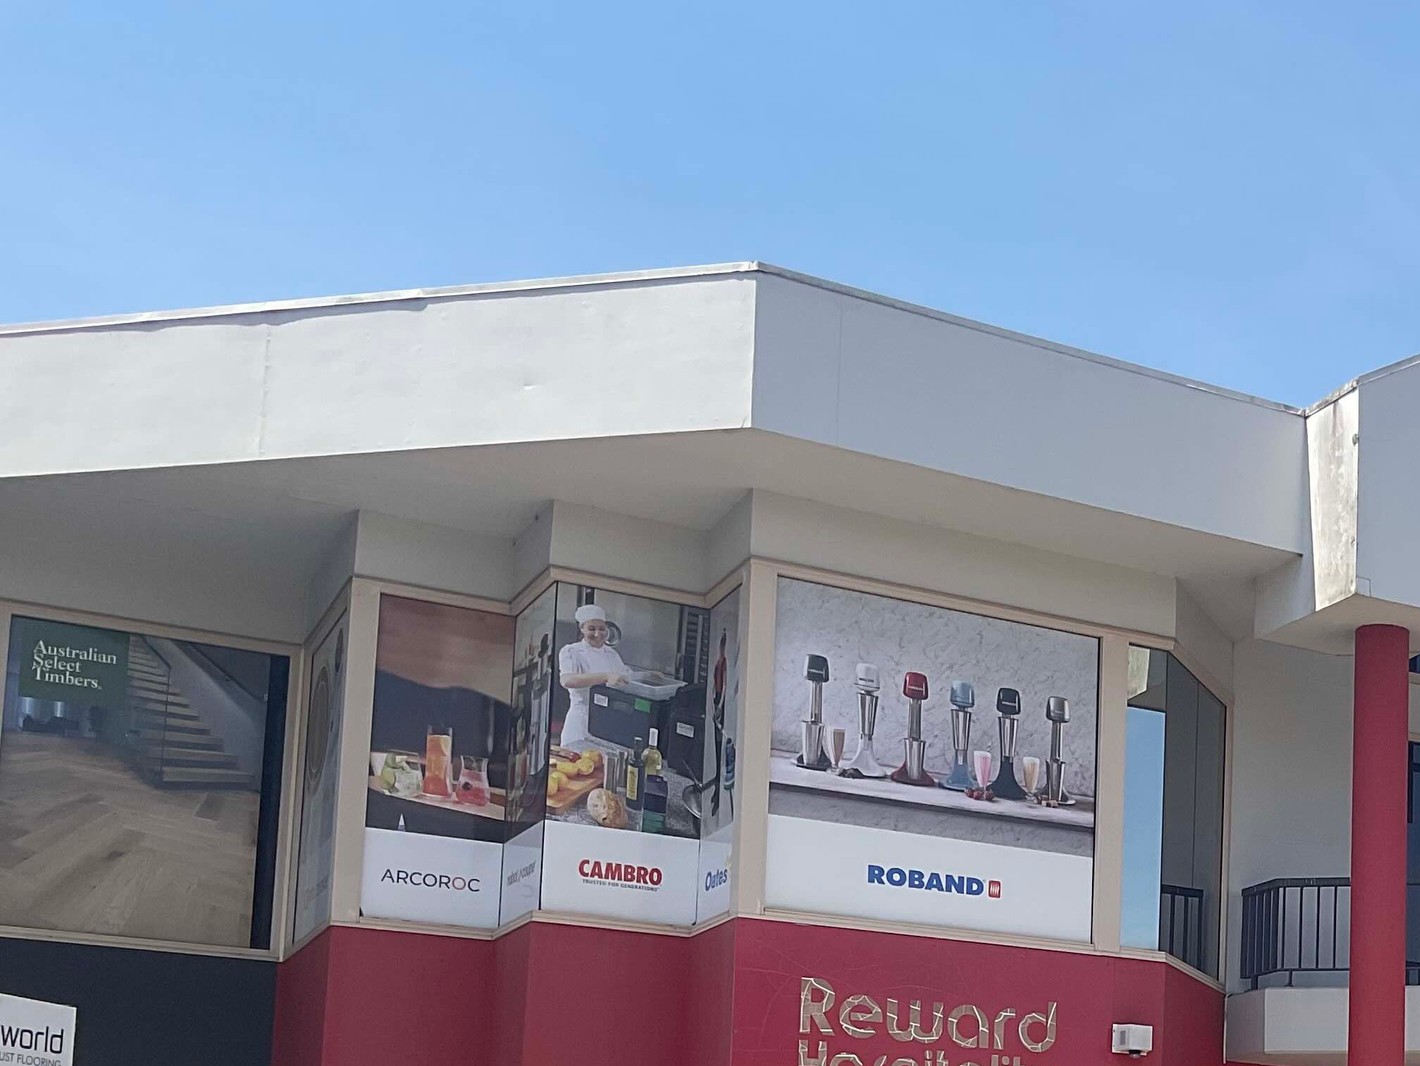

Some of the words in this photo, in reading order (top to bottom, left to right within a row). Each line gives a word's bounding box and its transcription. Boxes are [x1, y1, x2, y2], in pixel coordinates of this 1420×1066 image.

[33, 640, 117, 664] Australian
[33, 653, 81, 673] Select
[381, 869, 480, 892] ARCOROC
[578, 859, 663, 886] CAMBRO
[705, 869, 728, 891] Oates
[867, 864, 984, 896] ROBAND
[800, 977, 1057, 1053] Reward
[1, 1024, 64, 1054] world
